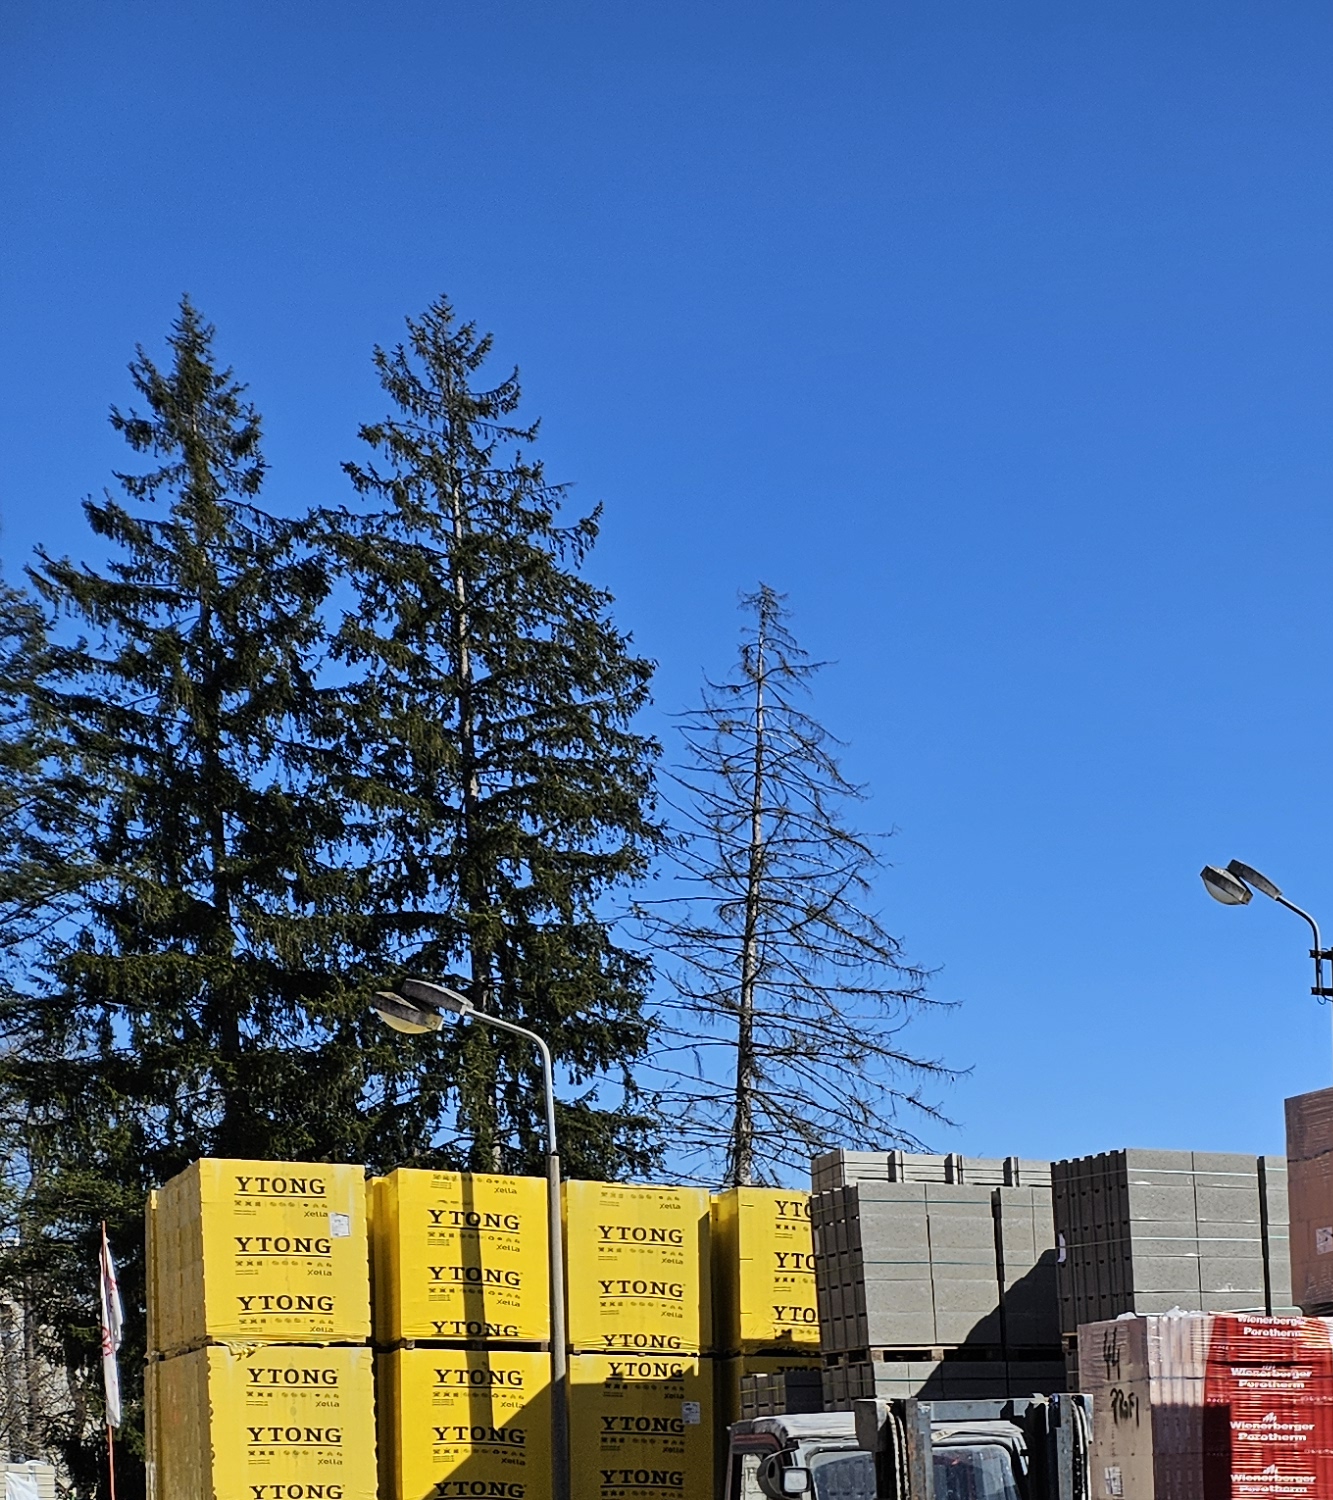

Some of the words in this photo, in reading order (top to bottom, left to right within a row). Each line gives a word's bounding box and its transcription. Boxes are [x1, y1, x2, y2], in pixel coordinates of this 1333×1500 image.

[236, 1177, 325, 1194] YTONG
[428, 1210, 520, 1230] YTONG
[598, 1226, 683, 1243] YTONG
[235, 1238, 331, 1253] YTONG
[428, 1267, 521, 1285] YTONG
[598, 1281, 683, 1297] YTONG
[238, 1295, 334, 1311] YTONG
[773, 1306, 816, 1323] YTO
[431, 1321, 518, 1336] YTONG
[1244, 1327, 1301, 1336] Porotherm
[603, 1334, 681, 1348] YTONG
[247, 1368, 338, 1385] YTONG
[434, 1369, 523, 1385] YTONG
[608, 1362, 683, 1377] YTONG
[1231, 1368, 1312, 1379] Wienerberger
[602, 1417, 684, 1432] YTONG
[1230, 1421, 1314, 1431] Wienerberger
[247, 1427, 342, 1442] YTONG
[433, 1427, 526, 1444] YTONG
[601, 1470, 683, 1485] YTONG
[1231, 1474, 1316, 1484] Wienerberger
[250, 1485, 343, 1499] YTONG
[434, 1482, 525, 1498] YTONG
